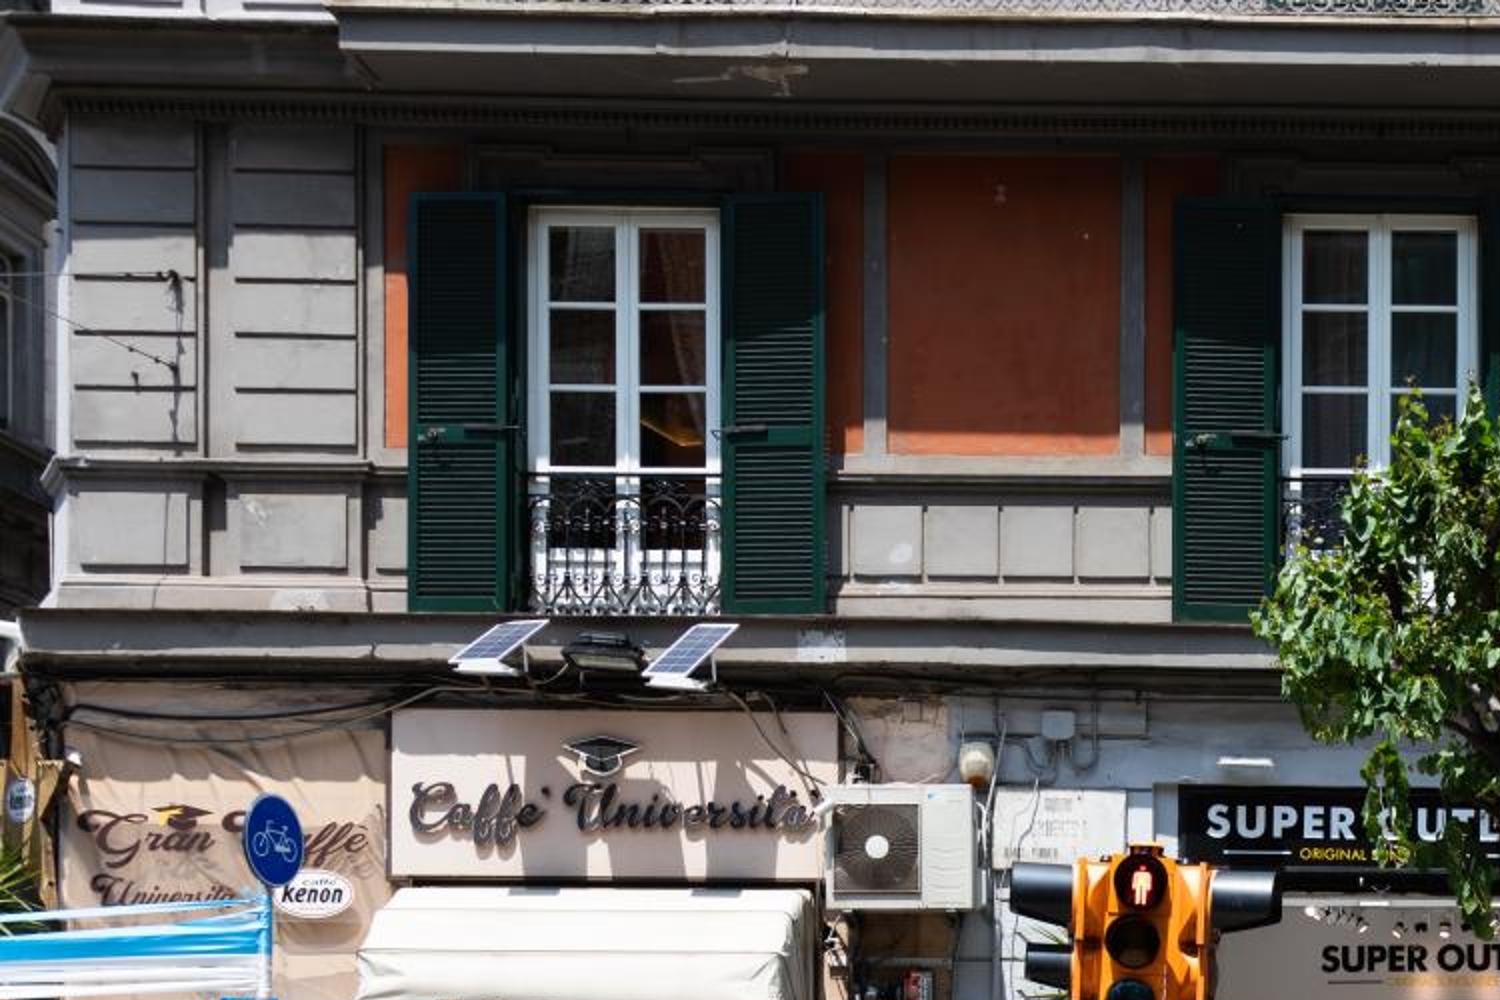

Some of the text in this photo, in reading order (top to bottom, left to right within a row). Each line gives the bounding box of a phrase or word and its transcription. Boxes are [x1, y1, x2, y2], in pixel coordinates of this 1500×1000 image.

[78, 810, 215, 868] Gran
[1206, 804, 1500, 843] SUPER OUTL
[1300, 847, 1367, 862] ORIGINAL
[1321, 944, 1428, 972] SUPER
